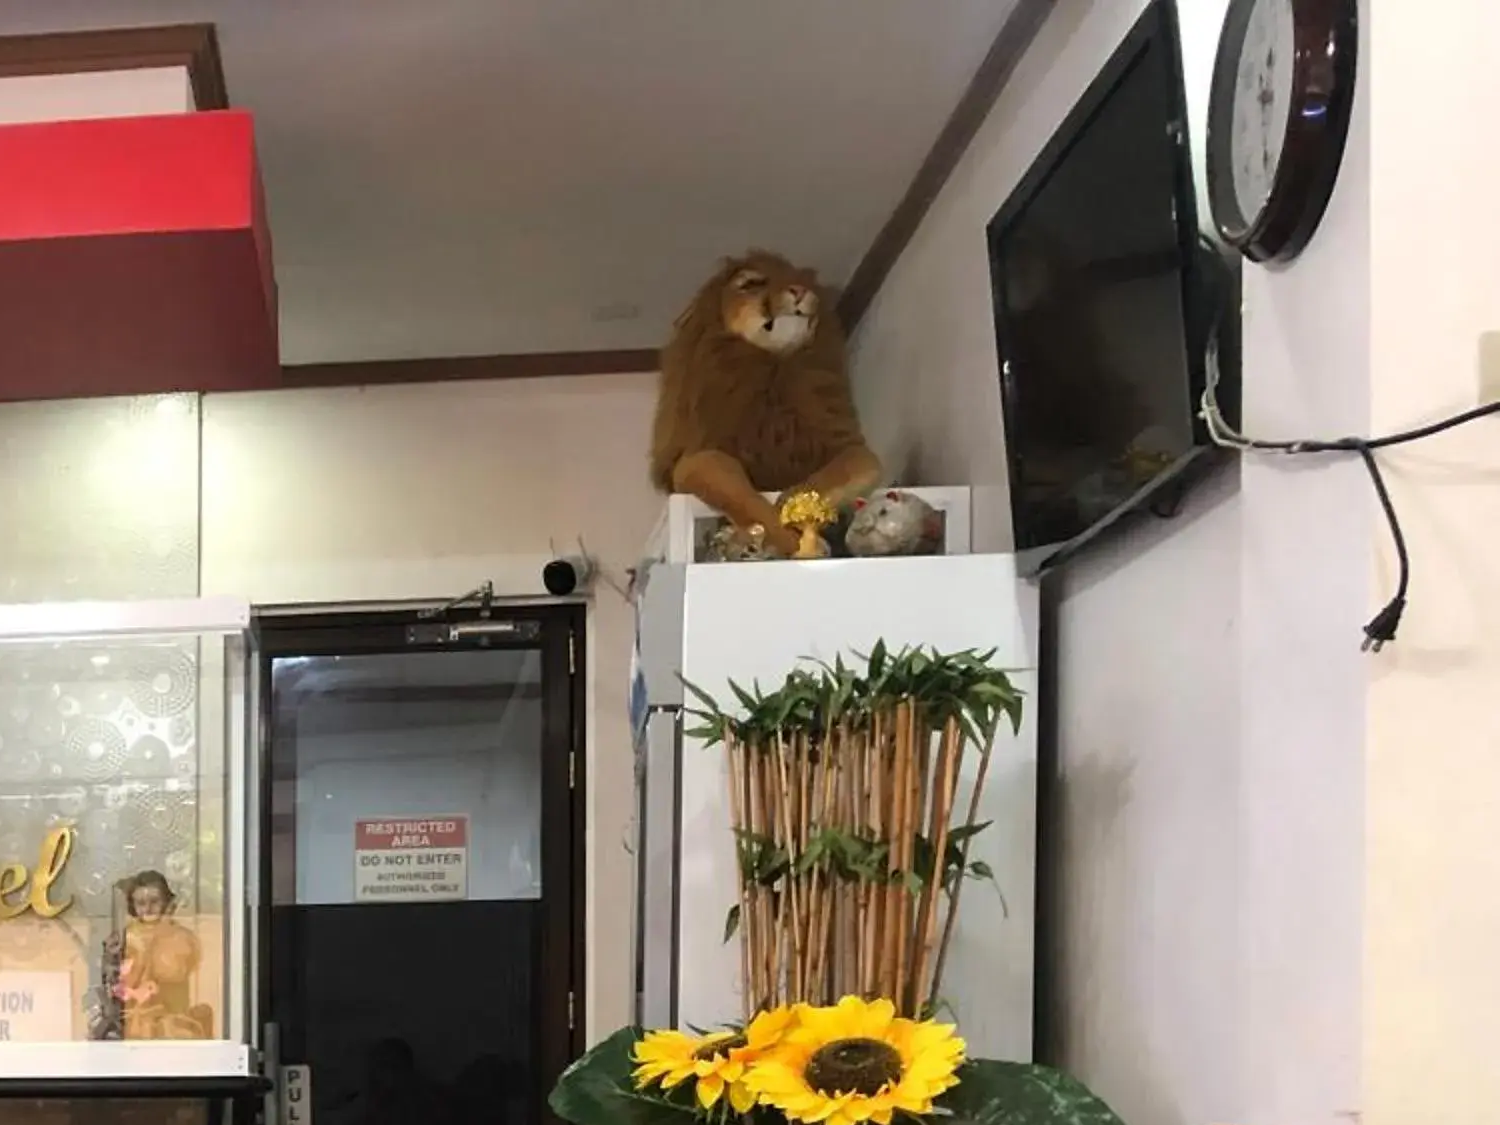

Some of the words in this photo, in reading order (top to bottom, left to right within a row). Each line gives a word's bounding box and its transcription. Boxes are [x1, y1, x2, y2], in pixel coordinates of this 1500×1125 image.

[391, 835, 431, 847] AREA
[360, 855, 381, 866] DO
[384, 854, 412, 865] NOT
[417, 852, 462, 865] ENTER
